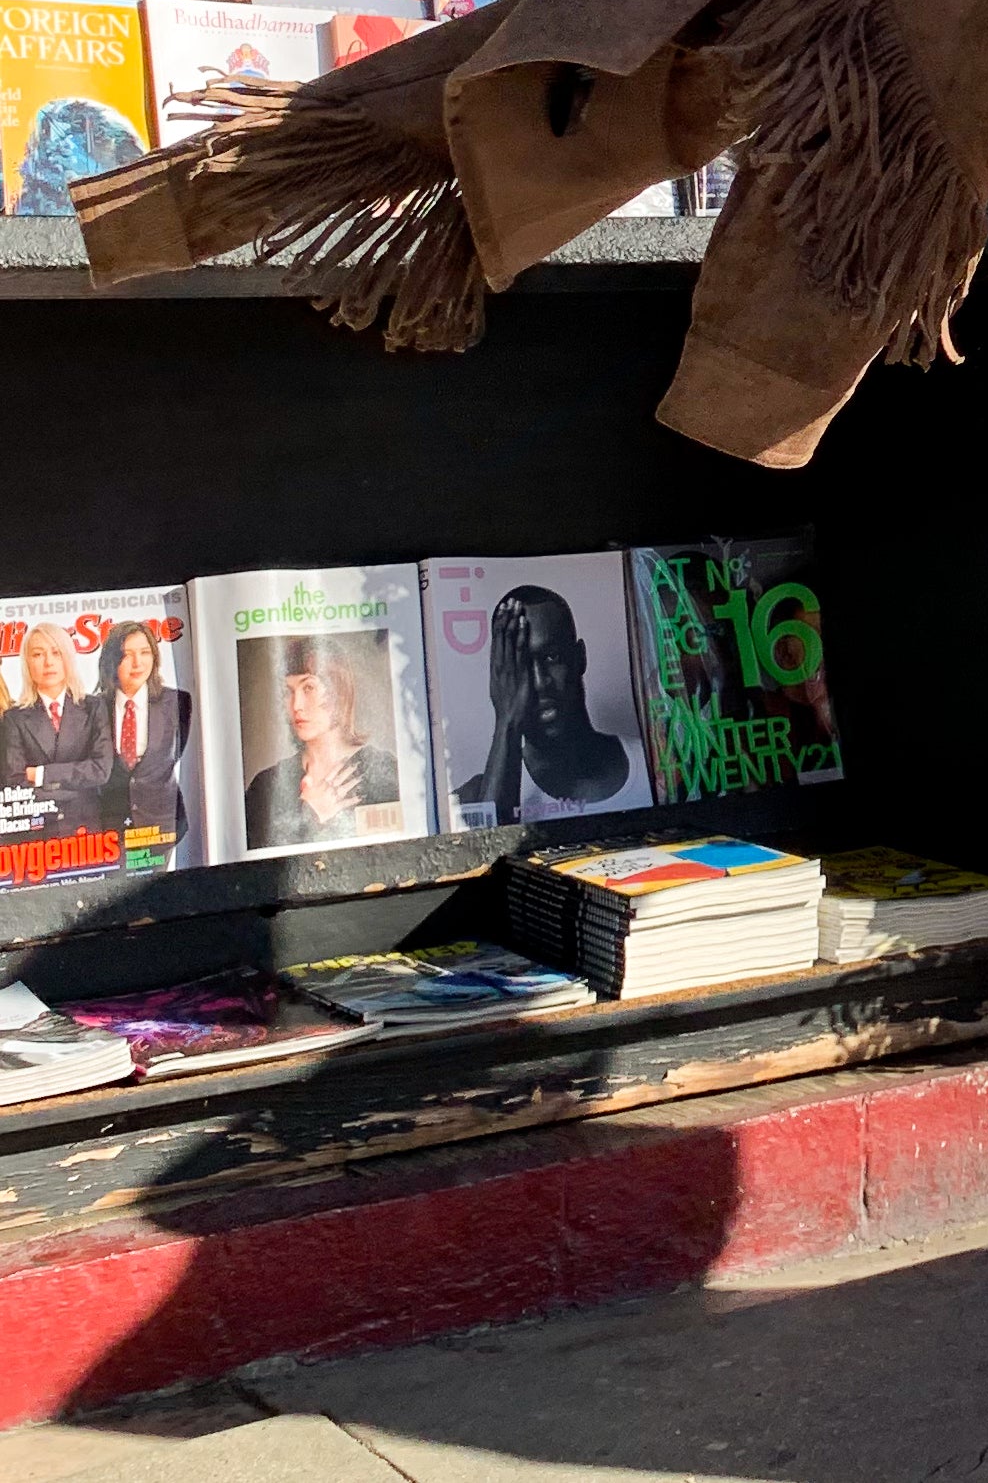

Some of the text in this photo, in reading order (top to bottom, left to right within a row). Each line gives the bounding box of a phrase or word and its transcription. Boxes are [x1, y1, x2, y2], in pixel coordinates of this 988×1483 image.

[0, 6, 131, 39] OREIGN
[174, 7, 315, 34] Buddhadharma
[0, 33, 126, 67] AFFAIRS
[5, 591, 182, 618] STYLISH MUSICIANS
[293, 580, 327, 606] the
[233, 597, 389, 633] gentlewoman
[712, 582, 824, 688] 16
[4, 785, 36, 803] Baker,
[0, 818, 31, 834] Dacus
